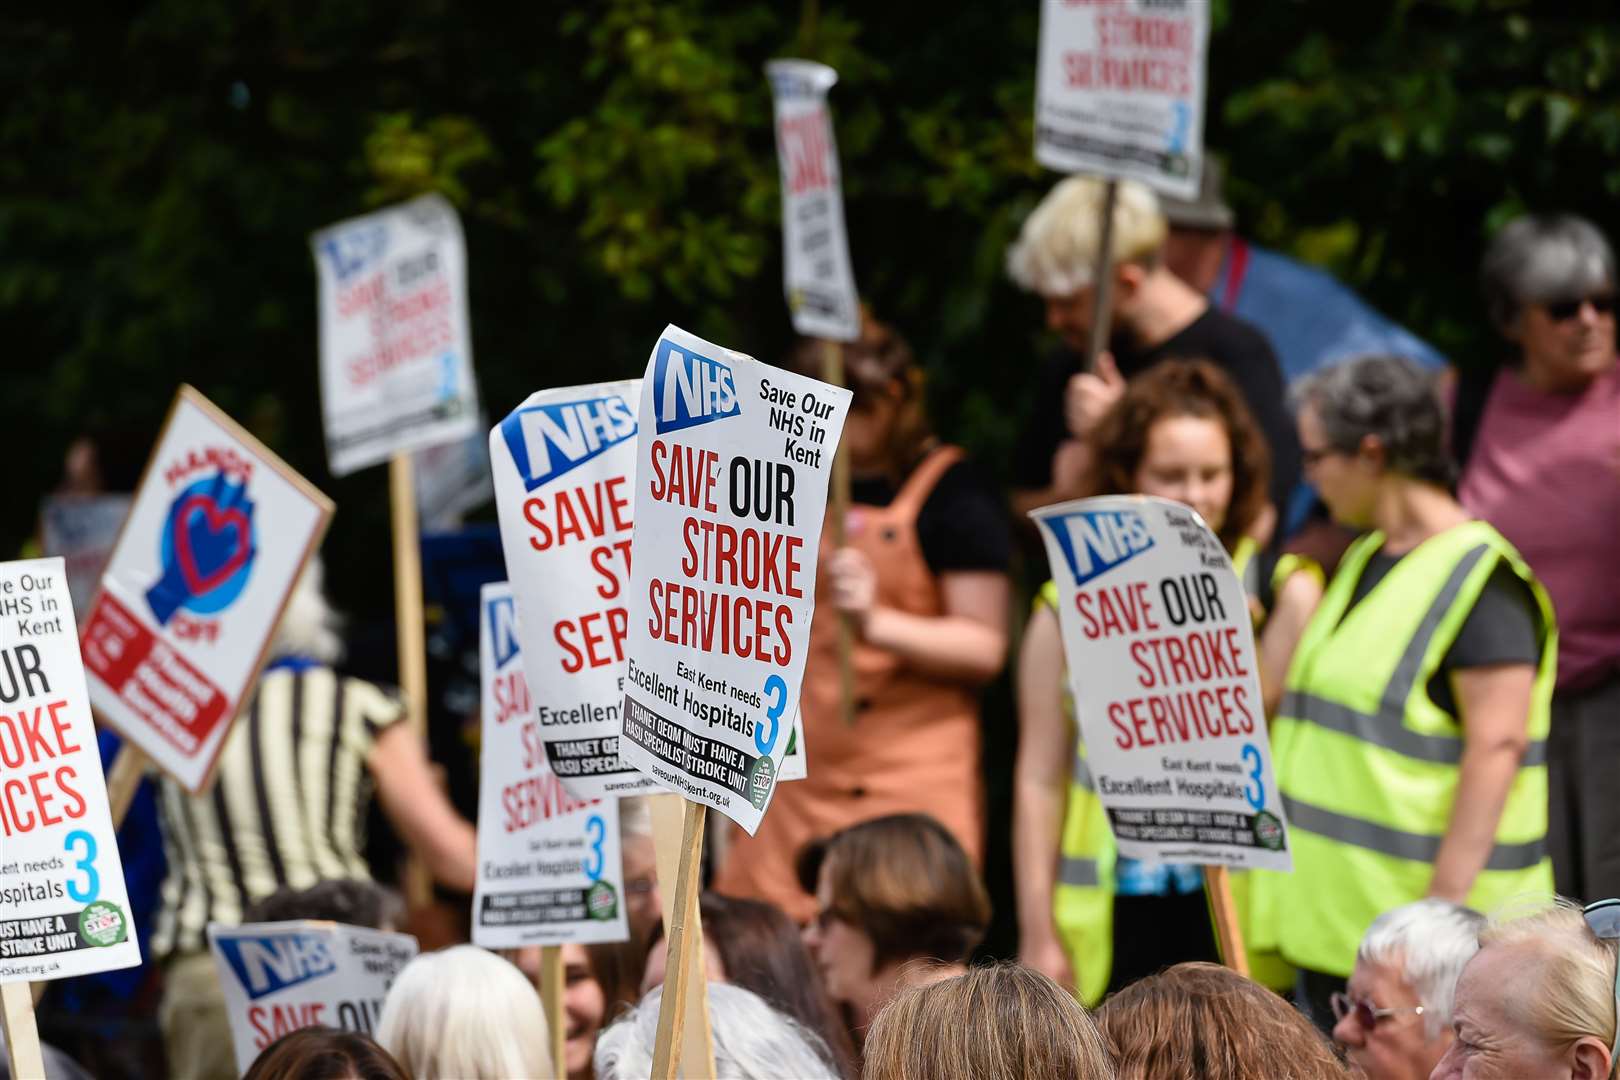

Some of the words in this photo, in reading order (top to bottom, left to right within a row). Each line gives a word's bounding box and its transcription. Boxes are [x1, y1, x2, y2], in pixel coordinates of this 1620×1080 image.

[662, 350, 739, 423] NHS
[759, 378, 796, 408] Save
[801, 393, 835, 420] Our
[519, 397, 637, 480] NHS
[769, 407, 804, 437] NHS
[809, 420, 826, 444] in
[784, 438, 821, 468] Kent
[523, 476, 633, 552] SAVE
[650, 440, 719, 513] SAVE
[729, 456, 795, 526] OUR
[682, 517, 803, 598] STROKE
[1063, 513, 1153, 577] NHS
[20, 574, 52, 592] Our
[41, 594, 58, 611] in
[1075, 582, 1160, 640] SAVE
[1160, 573, 1227, 627] OUR
[18, 616, 62, 636] Kent
[648, 578, 793, 666] SERVICES
[677, 661, 696, 684] East
[698, 672, 727, 695] Kent
[730, 685, 761, 709] needs
[1129, 628, 1248, 689] STROKE
[628, 658, 679, 707] Excellent
[683, 689, 754, 737] Hospitals
[754, 674, 788, 757] 3
[1107, 685, 1255, 750] SERVICES
[625, 718, 643, 742] HASU
[643, 730, 687, 766] SPECIALIST
[686, 754, 727, 783] STROKE
[728, 770, 748, 792] UNIT
[631, 702, 657, 731] THANET
[657, 720, 682, 743] QEQM
[682, 731, 708, 756] MUST
[710, 743, 738, 768] HAVE
[738, 755, 745, 771] A
[1241, 743, 1266, 812] 3
[24, 856, 64, 873] needs
[64, 829, 100, 904] 3
[583, 815, 606, 881] 3
[20, 917, 54, 936] HAVE
[55, 916, 67, 932] A
[45, 932, 77, 952] UNIT
[238, 938, 334, 993] NHS
